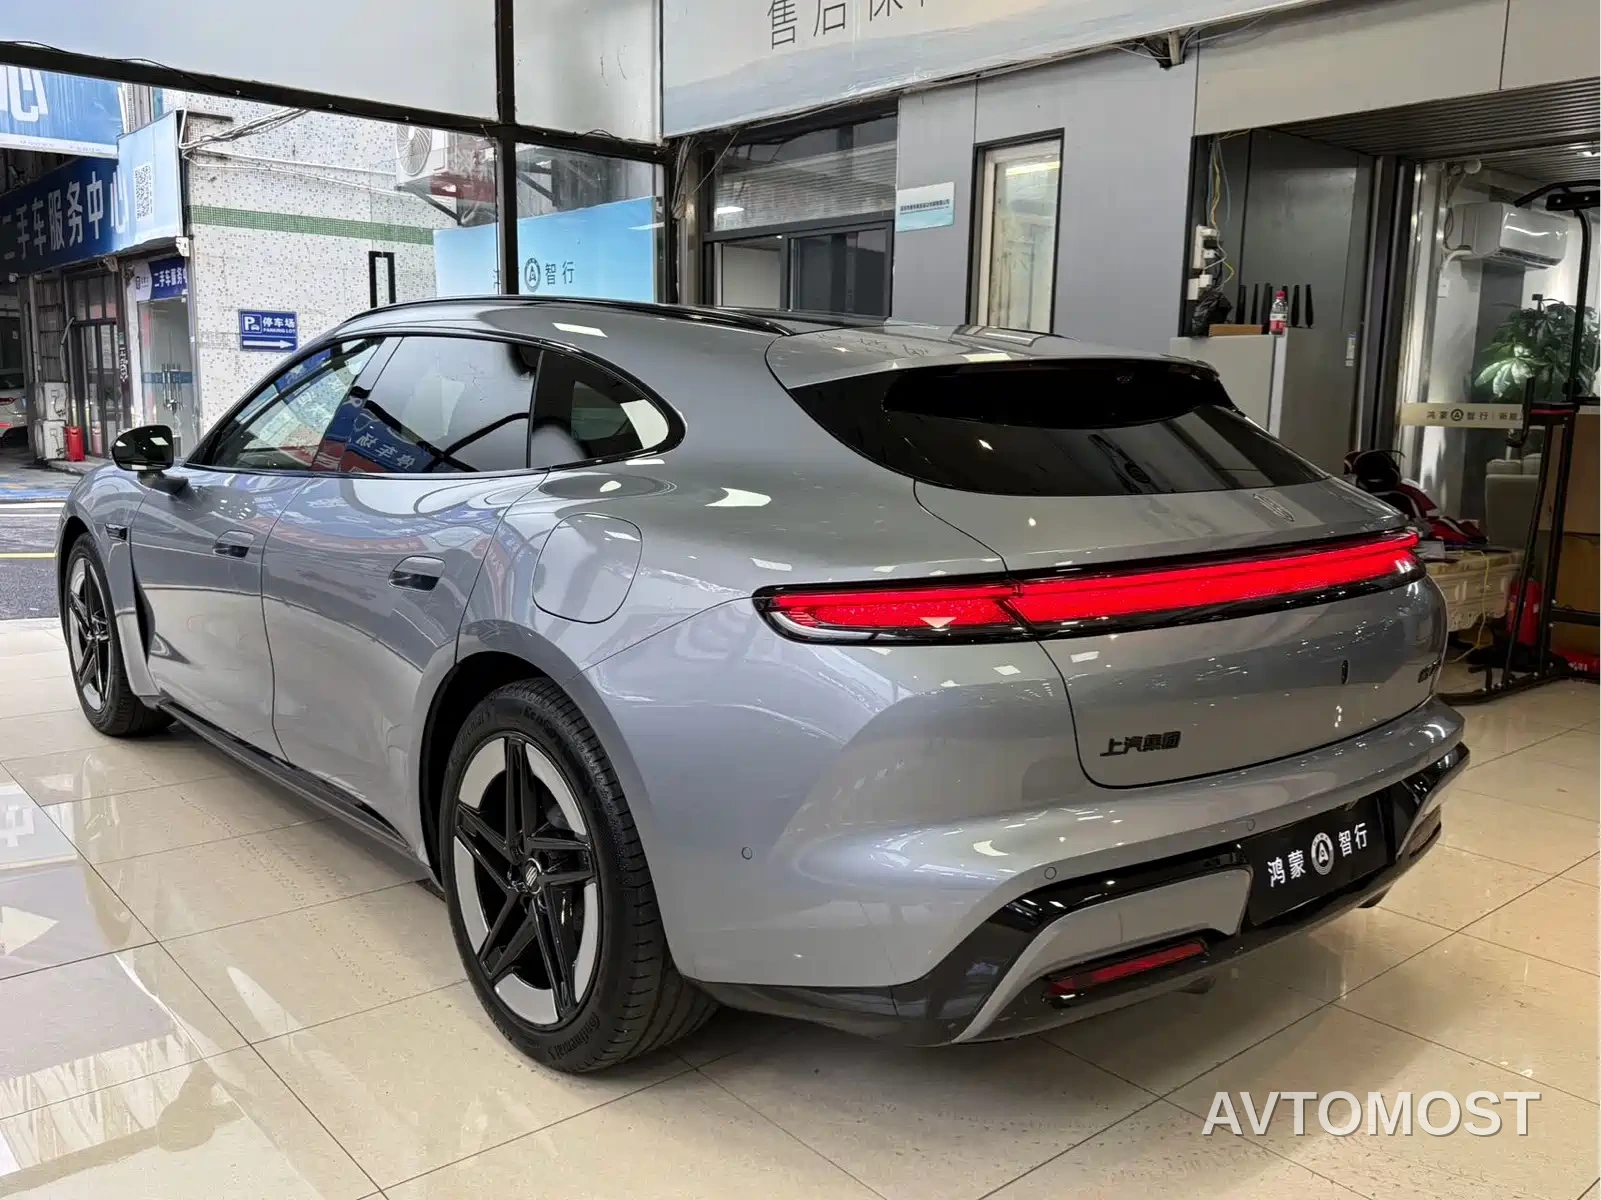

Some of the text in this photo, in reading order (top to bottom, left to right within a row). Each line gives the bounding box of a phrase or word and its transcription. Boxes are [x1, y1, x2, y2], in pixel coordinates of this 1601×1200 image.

[2, 165, 128, 260] 二手车服务中心
[244, 316, 256, 331] P
[263, 317, 295, 328] 停车场
[1100, 731, 1182, 757] 上汽集团
[1267, 849, 1307, 888] 鸿蒙
[1338, 822, 1368, 858] 智行
